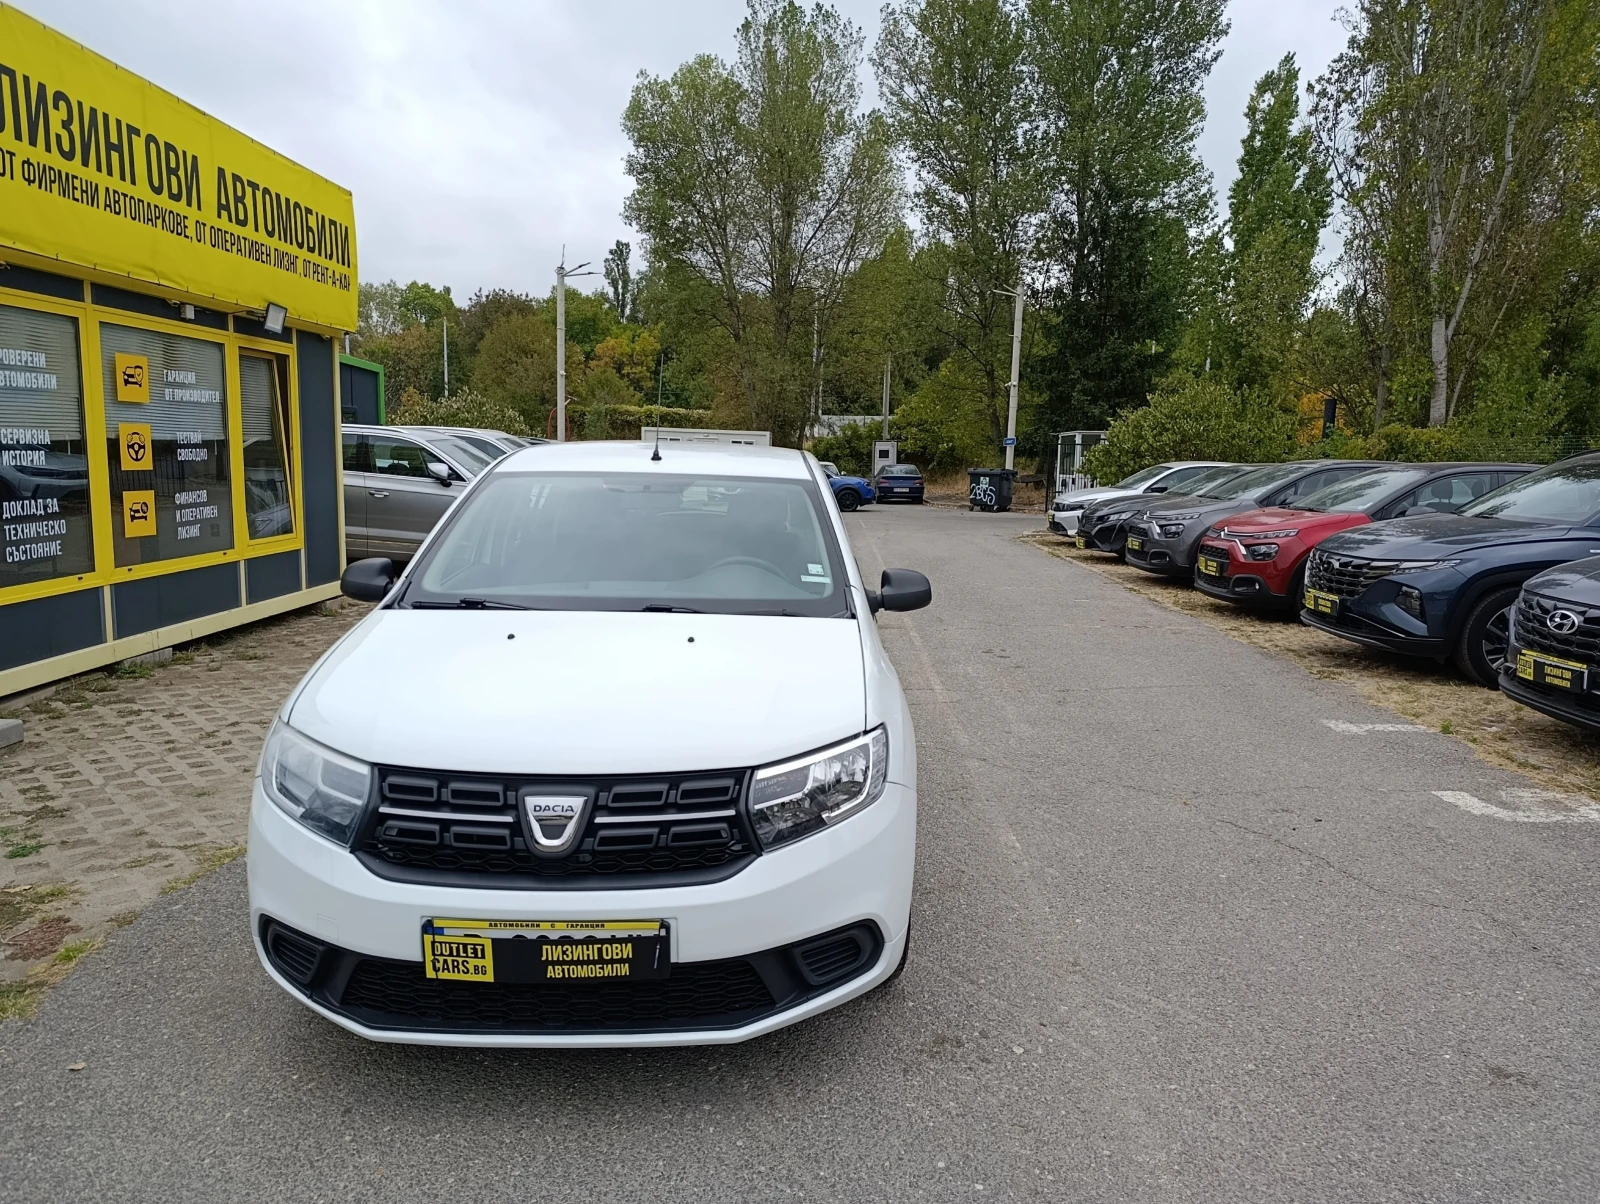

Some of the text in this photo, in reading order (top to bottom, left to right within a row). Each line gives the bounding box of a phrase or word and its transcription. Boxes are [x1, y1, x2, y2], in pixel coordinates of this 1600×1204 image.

[0, 63, 351, 269] ЛИЗИНГОВИ АВТОМОБИЛИ
[21, 157, 100, 210] ФИРМЕНИ
[103, 186, 193, 242] АВТОПАРКОВЕ,
[195, 220, 207, 245] ОТ
[209, 225, 272, 266] ОПЕРАТИВЕН
[302, 258, 312, 280] ОТ
[163, 369, 196, 384] ГАРАНЦИЯ
[165, 388, 220, 403] ОТ ПРОИЗВОДИТЕЛ
[0, 428, 51, 445] СЕРВИЗНА
[176, 430, 202, 444] ТЕСТВАЙ
[1, 450, 46, 466] ИСТОРИЯ
[177, 448, 208, 461] СВОБОДНО
[174, 489, 208, 505] ФИНАНСОВ
[2, 498, 59, 520] ДОКЛАД ЗА
[175, 505, 218, 523] И ОПЕРАТИВЕН
[4, 519, 67, 541] ТЕХНИЧЕСКО
[177, 523, 201, 540] ЛИЗИНГ
[5, 540, 63, 563] СЪСТОЯНИЕ
[533, 804, 575, 813] DACIA
[434, 942, 484, 959] OUTLET
[541, 943, 633, 961] ЛИЗИНГОВИ
[431, 957, 488, 976] CARS.BG
[546, 963, 630, 979] АВТОМОБИЛИ
